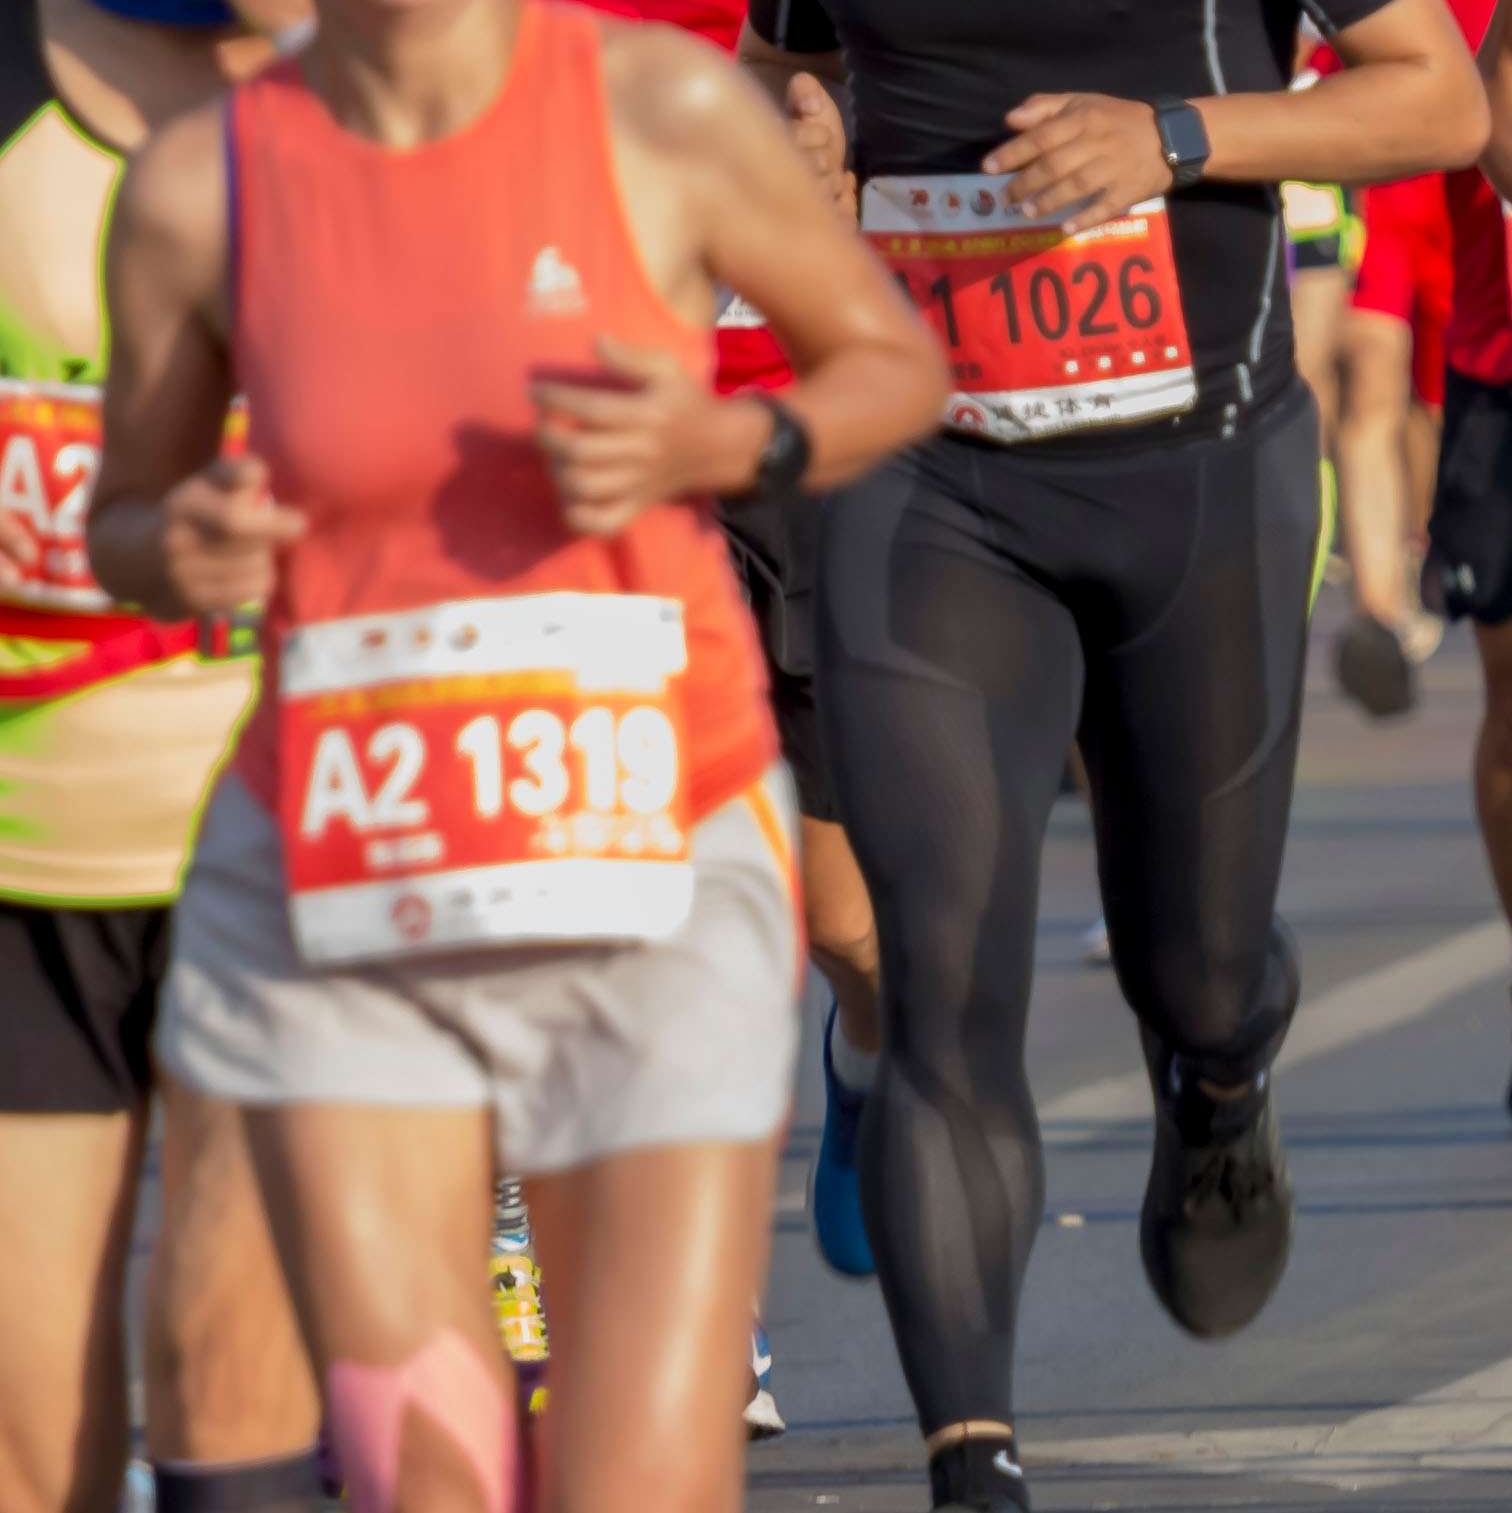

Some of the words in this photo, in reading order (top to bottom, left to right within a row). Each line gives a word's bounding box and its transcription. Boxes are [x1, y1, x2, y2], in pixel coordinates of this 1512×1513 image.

[896, 271, 960, 346] 1
[989, 254, 1162, 345] 1026
[302, 721, 427, 840] A2
[456, 706, 680, 818] 1319
